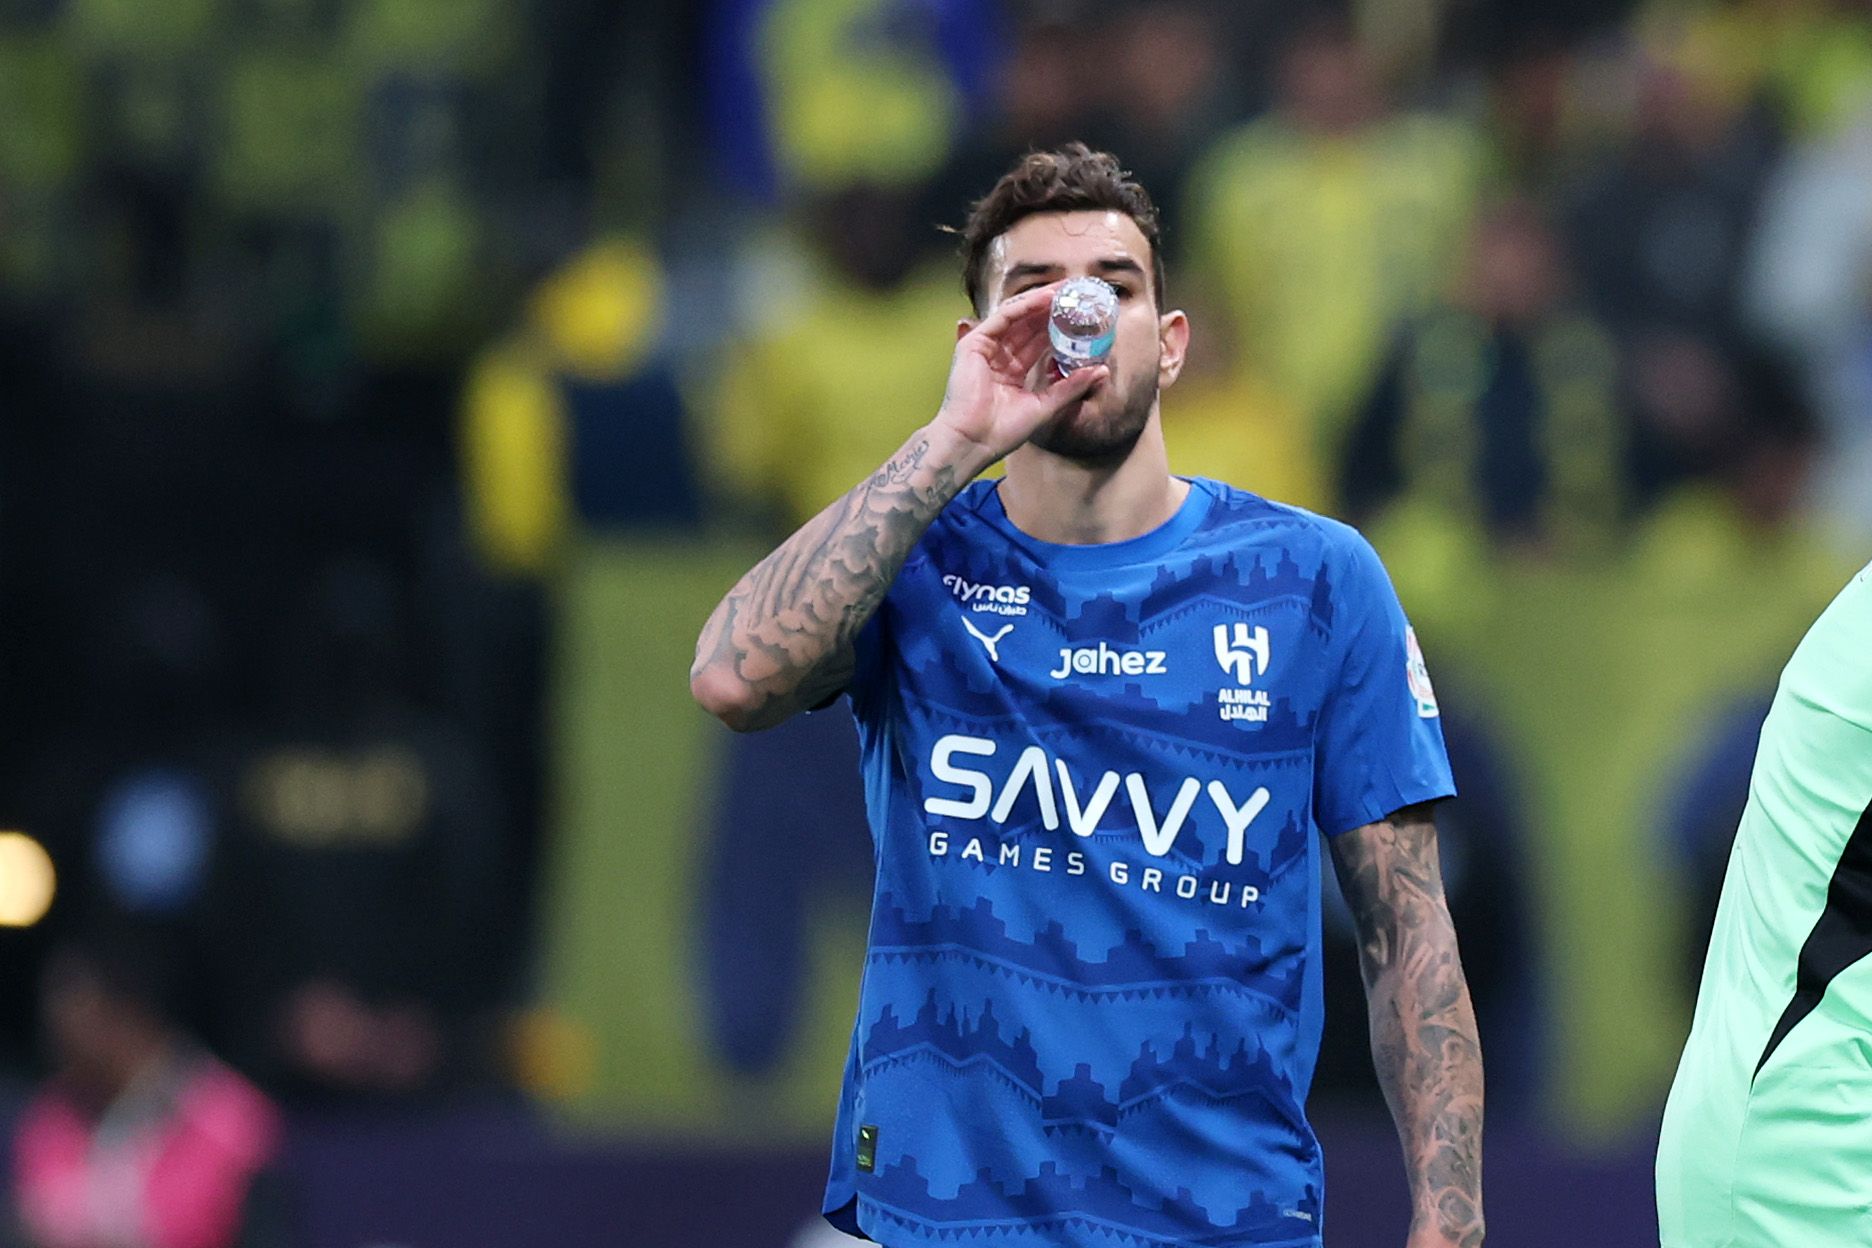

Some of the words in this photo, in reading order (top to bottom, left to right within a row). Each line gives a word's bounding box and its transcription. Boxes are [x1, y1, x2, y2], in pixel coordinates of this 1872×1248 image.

[943, 575, 1031, 605] flynas
[1050, 641, 1167, 679] jahez
[1220, 703, 1268, 722] الهلال
[925, 734, 1270, 865] SAVVY
[929, 833, 1085, 875] GAMES
[1109, 863, 1259, 908] GROUP
